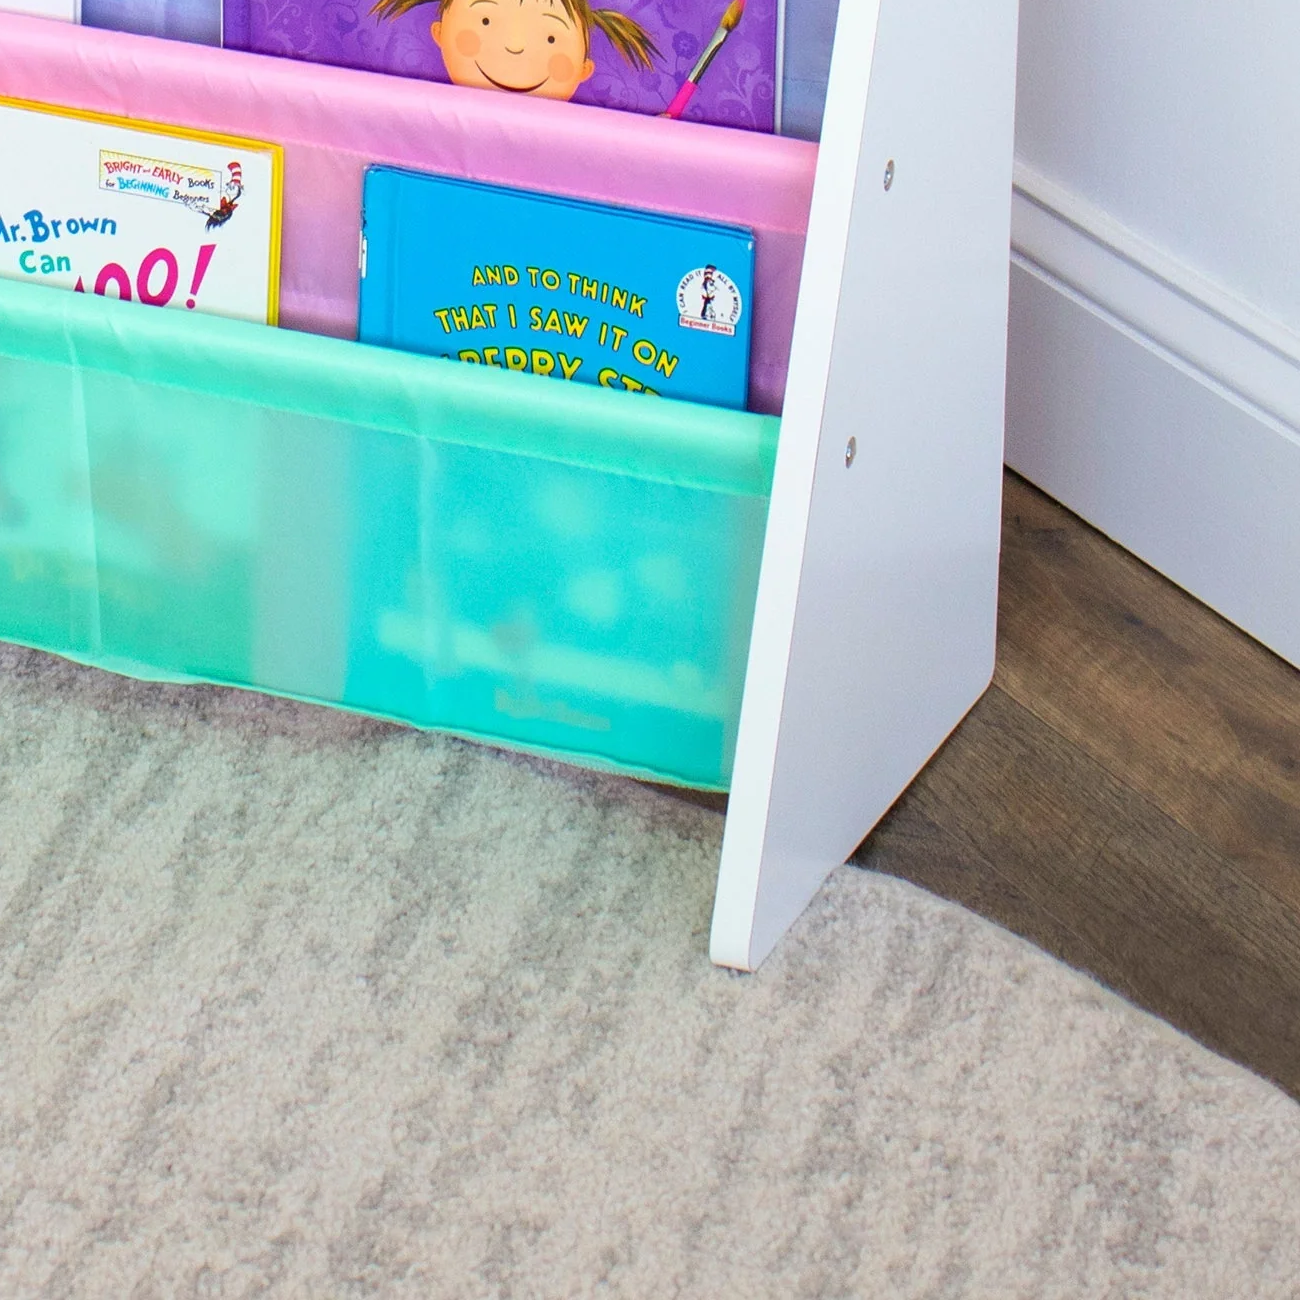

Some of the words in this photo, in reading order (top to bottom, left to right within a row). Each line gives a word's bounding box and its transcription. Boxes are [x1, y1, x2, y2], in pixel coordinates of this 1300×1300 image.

[104, 161, 143, 174] BRIGHT
[152, 166, 184, 185] EARLY
[105, 179, 115, 187] for
[117, 176, 170, 198] BEGINNING
[23, 209, 117, 243] Brown
[19, 250, 71, 274] Can
[471, 265, 520, 286] AND
[526, 266, 561, 291] TO
[567, 273, 648, 318] THINK
[681, 317, 710, 328] Beginner
[711, 322, 733, 333] Books
[433, 303, 497, 334] THAT
[508, 303, 518, 329] I
[528, 306, 589, 339] SAW
[598, 322, 628, 352] IT
[632, 338, 679, 379] ON
